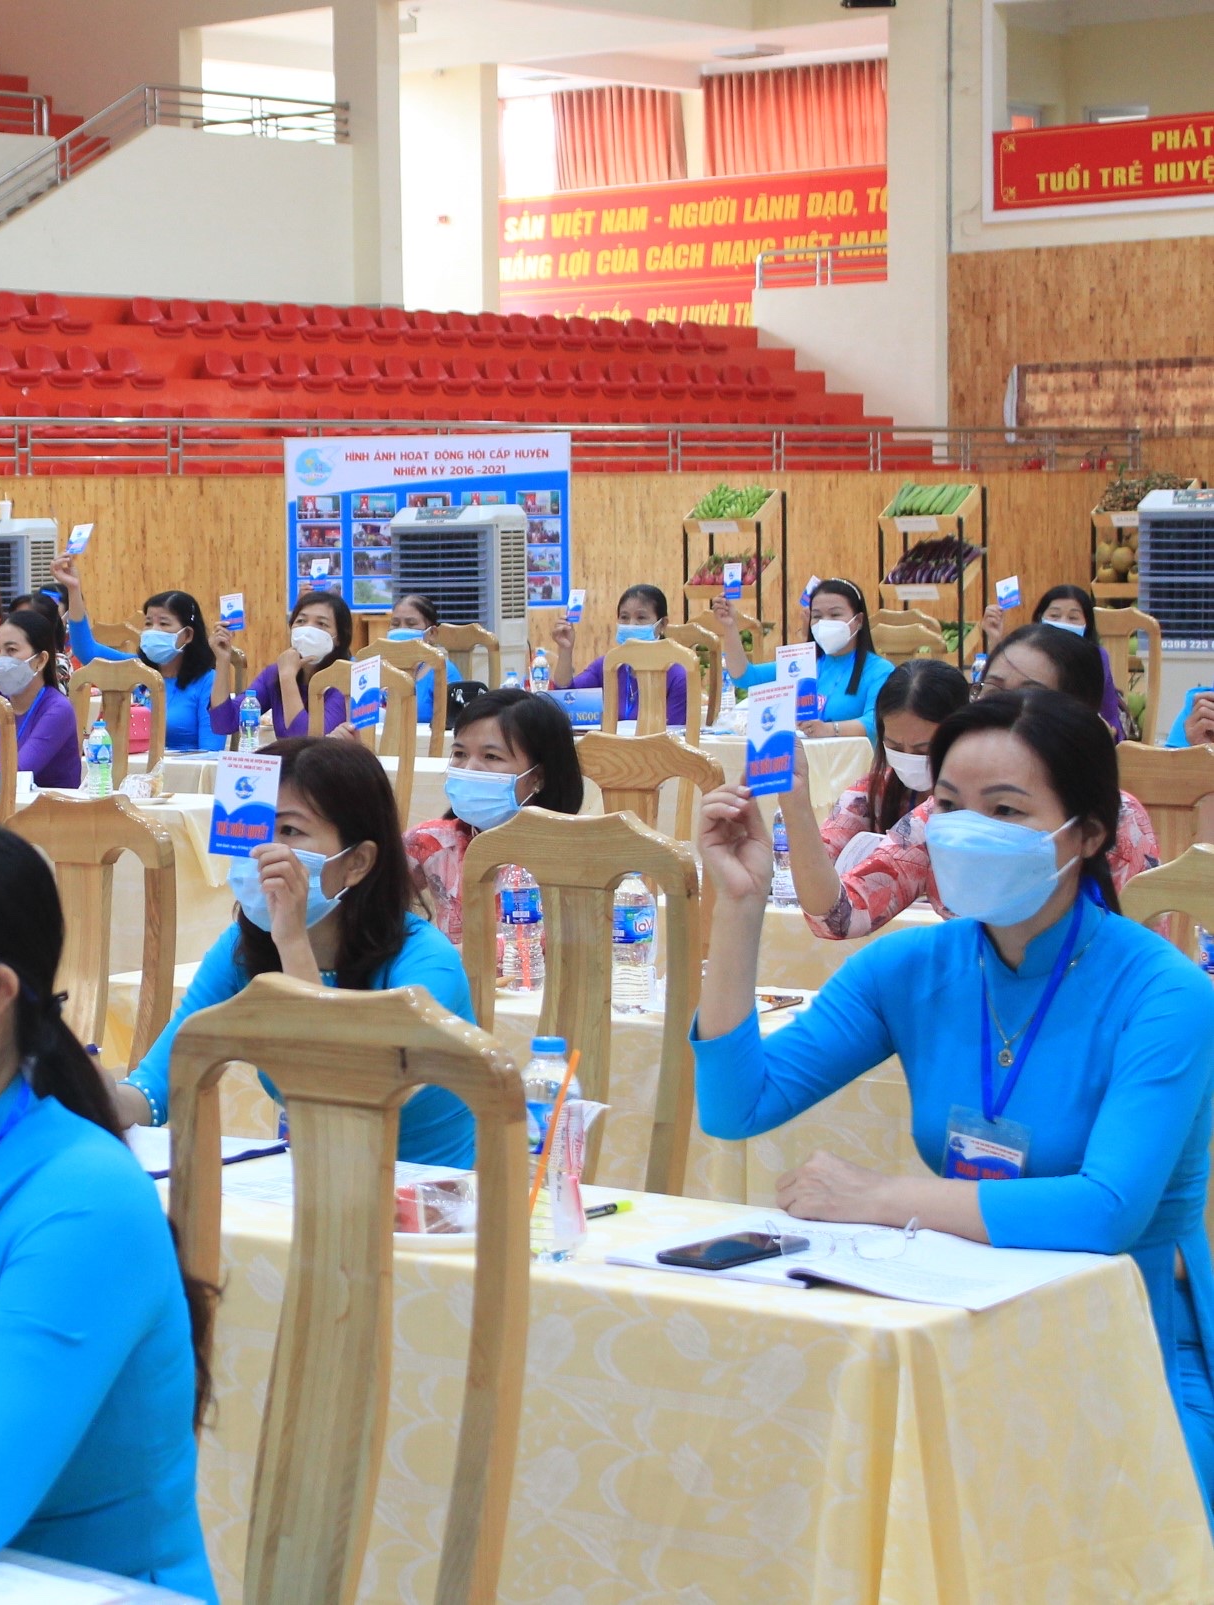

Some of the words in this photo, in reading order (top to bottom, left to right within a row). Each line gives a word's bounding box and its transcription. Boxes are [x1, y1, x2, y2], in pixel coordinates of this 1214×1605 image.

[1036, 163, 1090, 193] TUỔI
[1099, 160, 1143, 188] TRẺ
[504, 210, 546, 243] SẢN
[550, 207, 596, 241] VIỆT
[600, 206, 649, 234] NAM
[668, 195, 737, 229] NGƯỜI
[743, 193, 800, 224] LÃNH
[806, 189, 858, 222] ĐẠO,
[558, 248, 591, 282] LỢI
[596, 243, 639, 276] CỦA
[645, 241, 705, 272] CÁCH
[710, 237, 777, 271] MẠNG
[345, 450, 369, 461] HÌNH
[374, 449, 396, 461] ẢNH
[489, 447, 510, 459] CẤP
[514, 448, 549, 460] HUYỆN
[393, 465, 427, 477] NHIỆM
[450, 466, 474, 475] 2016
